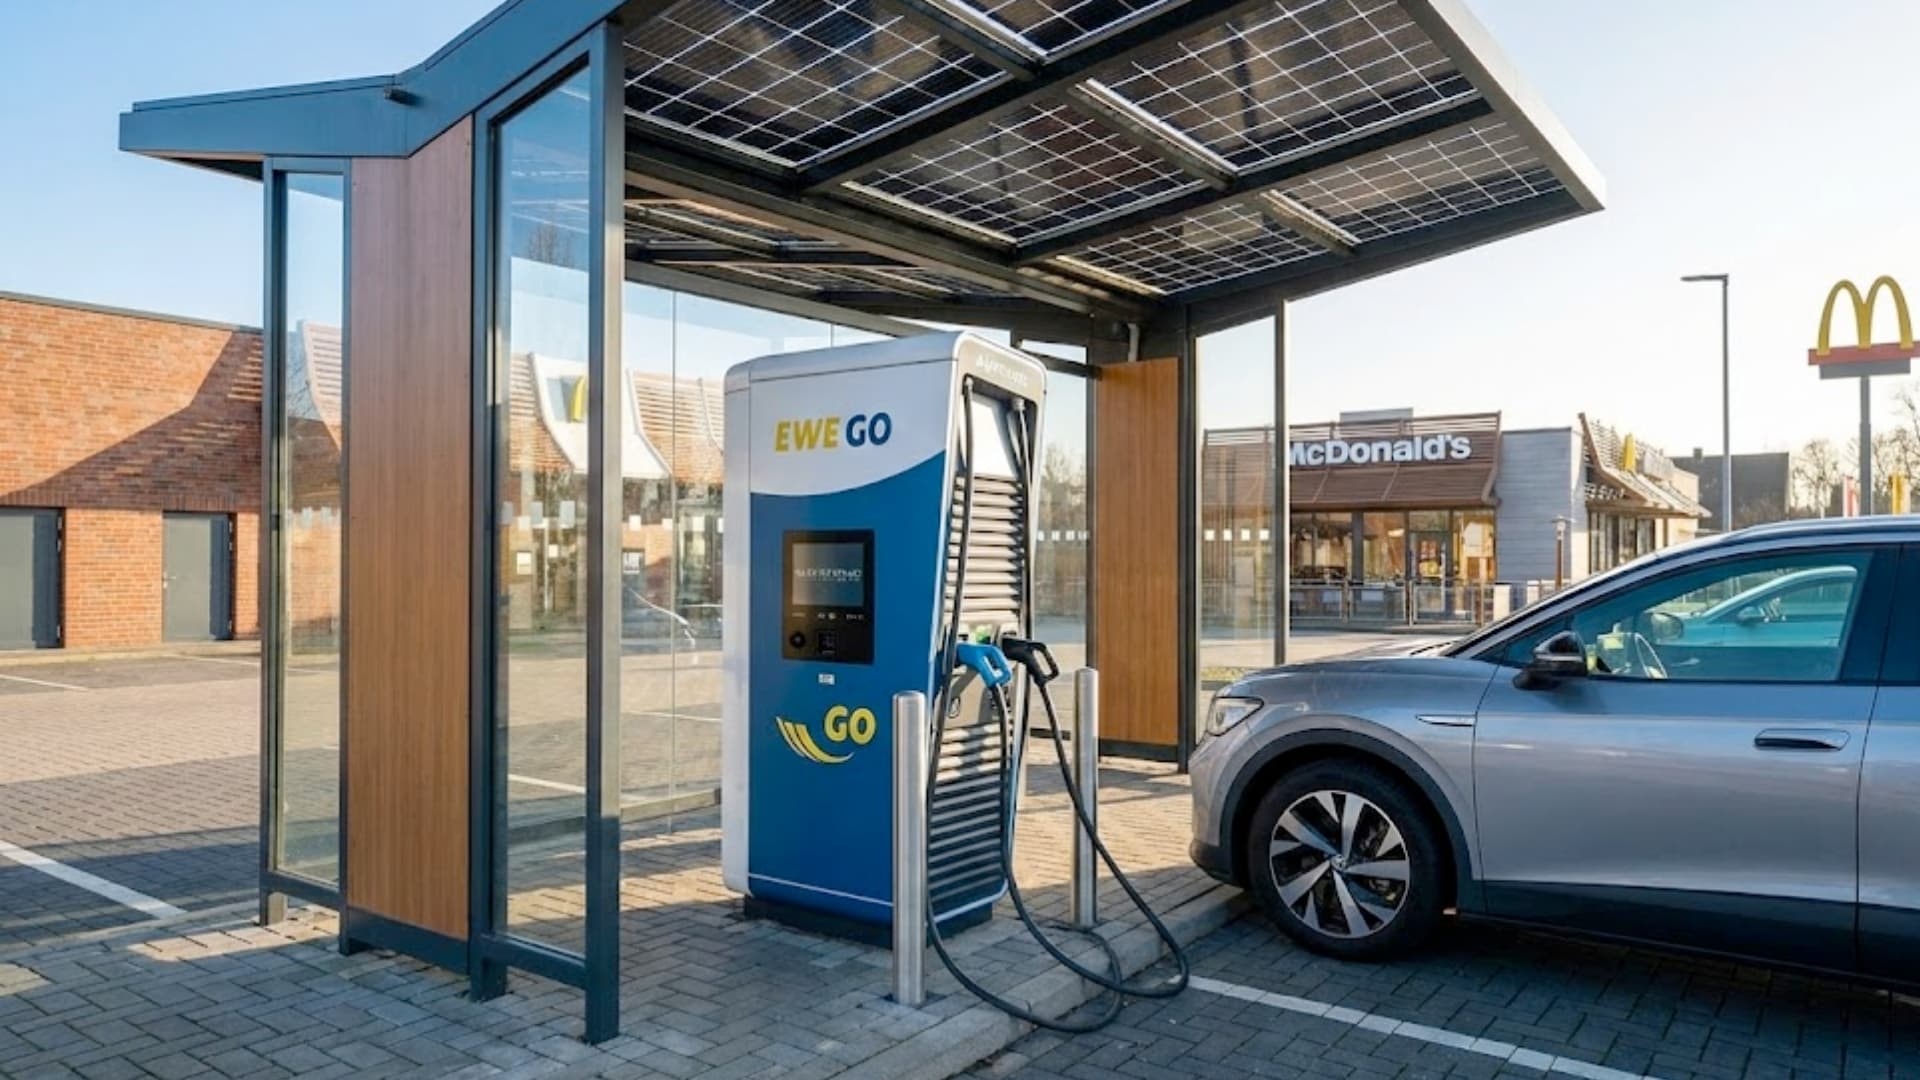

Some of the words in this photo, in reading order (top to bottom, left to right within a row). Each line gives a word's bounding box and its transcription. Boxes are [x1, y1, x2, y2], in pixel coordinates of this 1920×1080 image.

[775, 417, 840, 452] EWE
[846, 412, 892, 447] GO
[824, 705, 876, 745] GO
